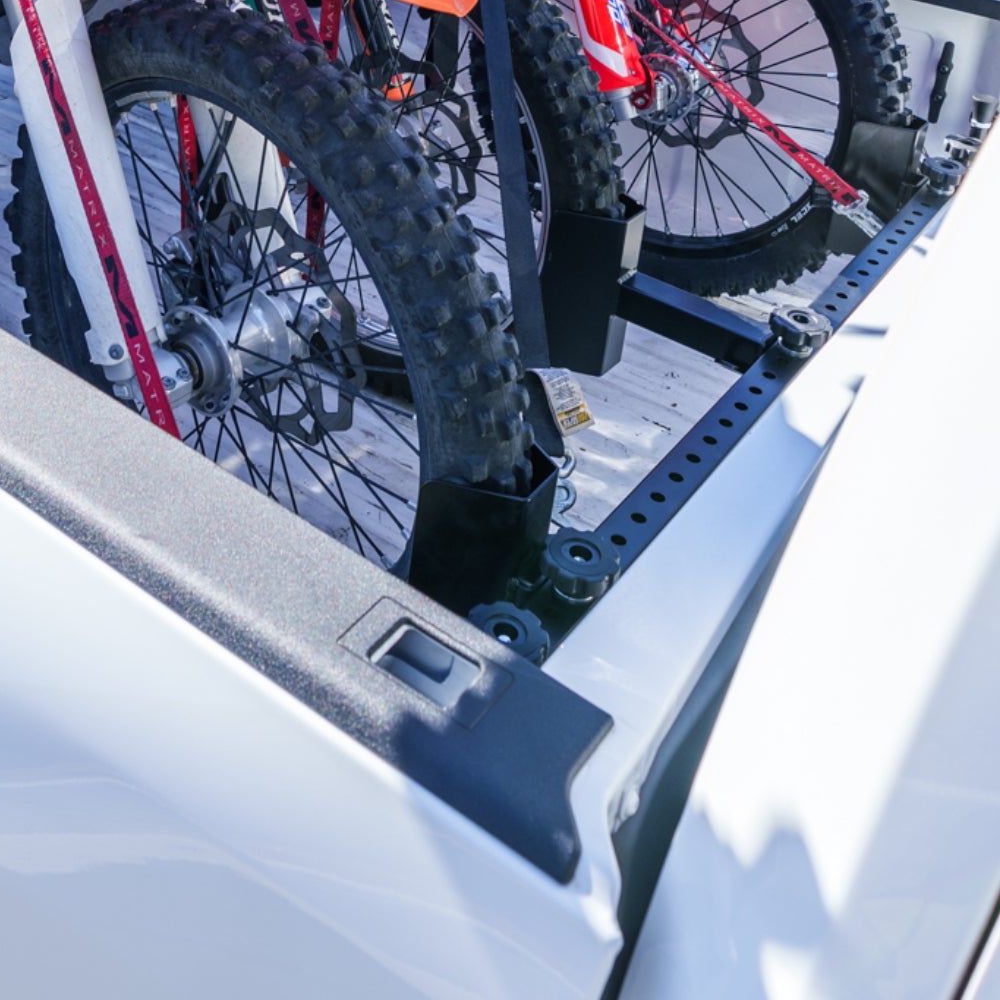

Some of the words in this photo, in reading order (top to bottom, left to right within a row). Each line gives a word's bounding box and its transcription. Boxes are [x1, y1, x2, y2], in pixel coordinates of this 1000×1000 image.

[718, 82, 765, 125] MATRIX
[67, 139, 109, 249] MATRIX
[797, 153, 844, 193] MATRIX
[134, 342, 167, 428] MATR
